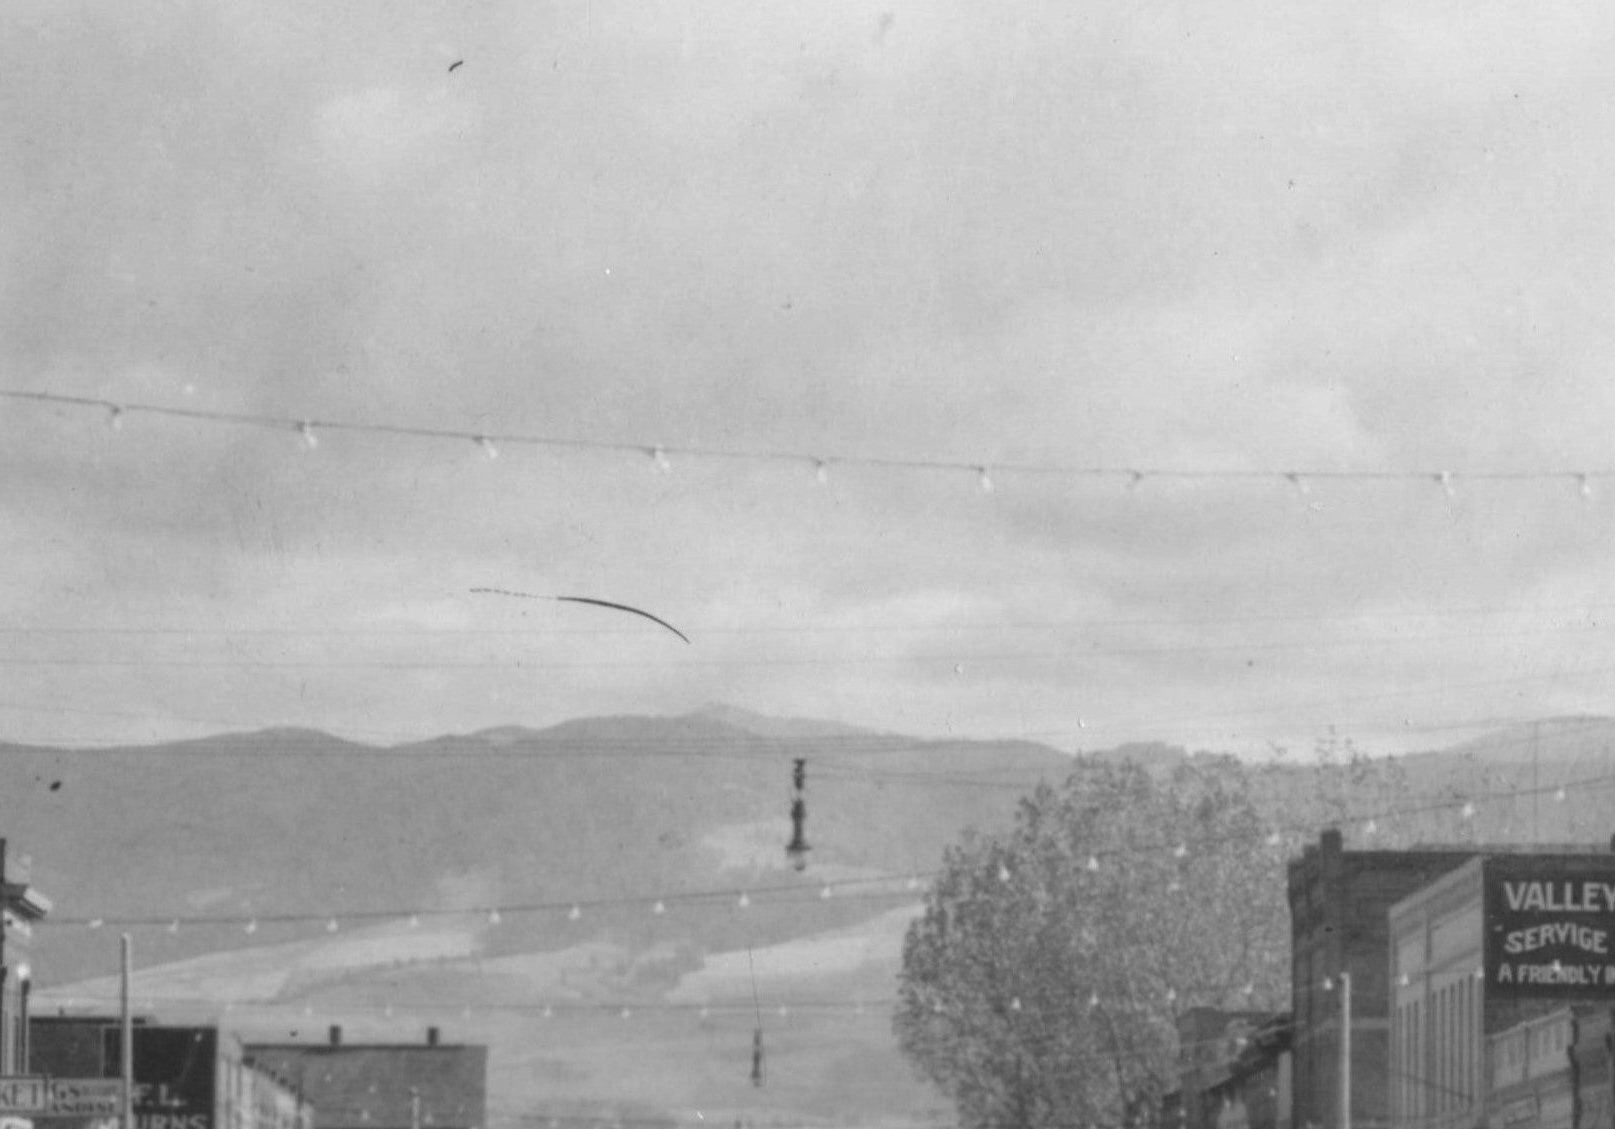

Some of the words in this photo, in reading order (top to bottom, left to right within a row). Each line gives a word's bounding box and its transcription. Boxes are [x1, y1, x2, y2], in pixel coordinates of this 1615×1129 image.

[1504, 922, 1608, 954] SERVICE
[1498, 962, 1513, 983] A
[1517, 964, 1602, 985] FRIENDLY
